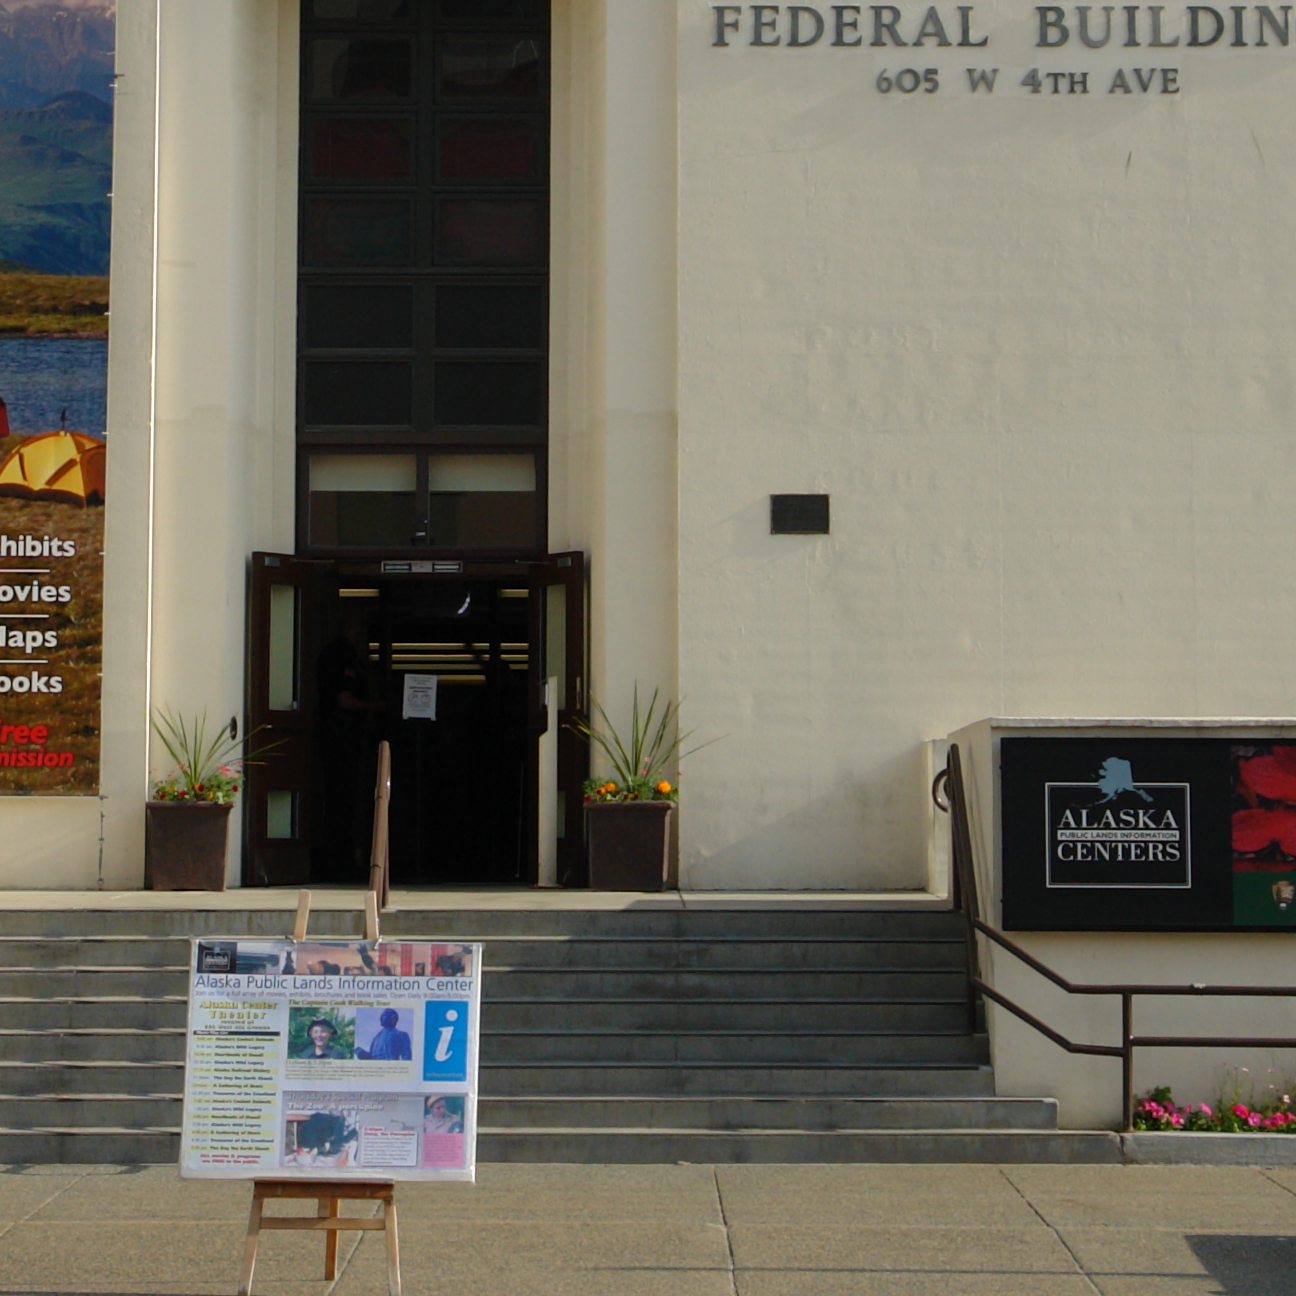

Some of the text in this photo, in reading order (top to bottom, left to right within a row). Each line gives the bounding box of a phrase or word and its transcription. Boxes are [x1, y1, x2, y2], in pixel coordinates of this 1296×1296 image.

[712, 5, 989, 47] FEDERAL
[876, 68, 1180, 94] 605 W 4TH AVE
[1057, 809, 1178, 828] ALASKA
[1057, 842, 1180, 862] CENTERS
[195, 974, 473, 991] Alaska Public Lands Information Center
[210, 1010, 266, 1019] Theater
[242, 1001, 278, 1010] Center
